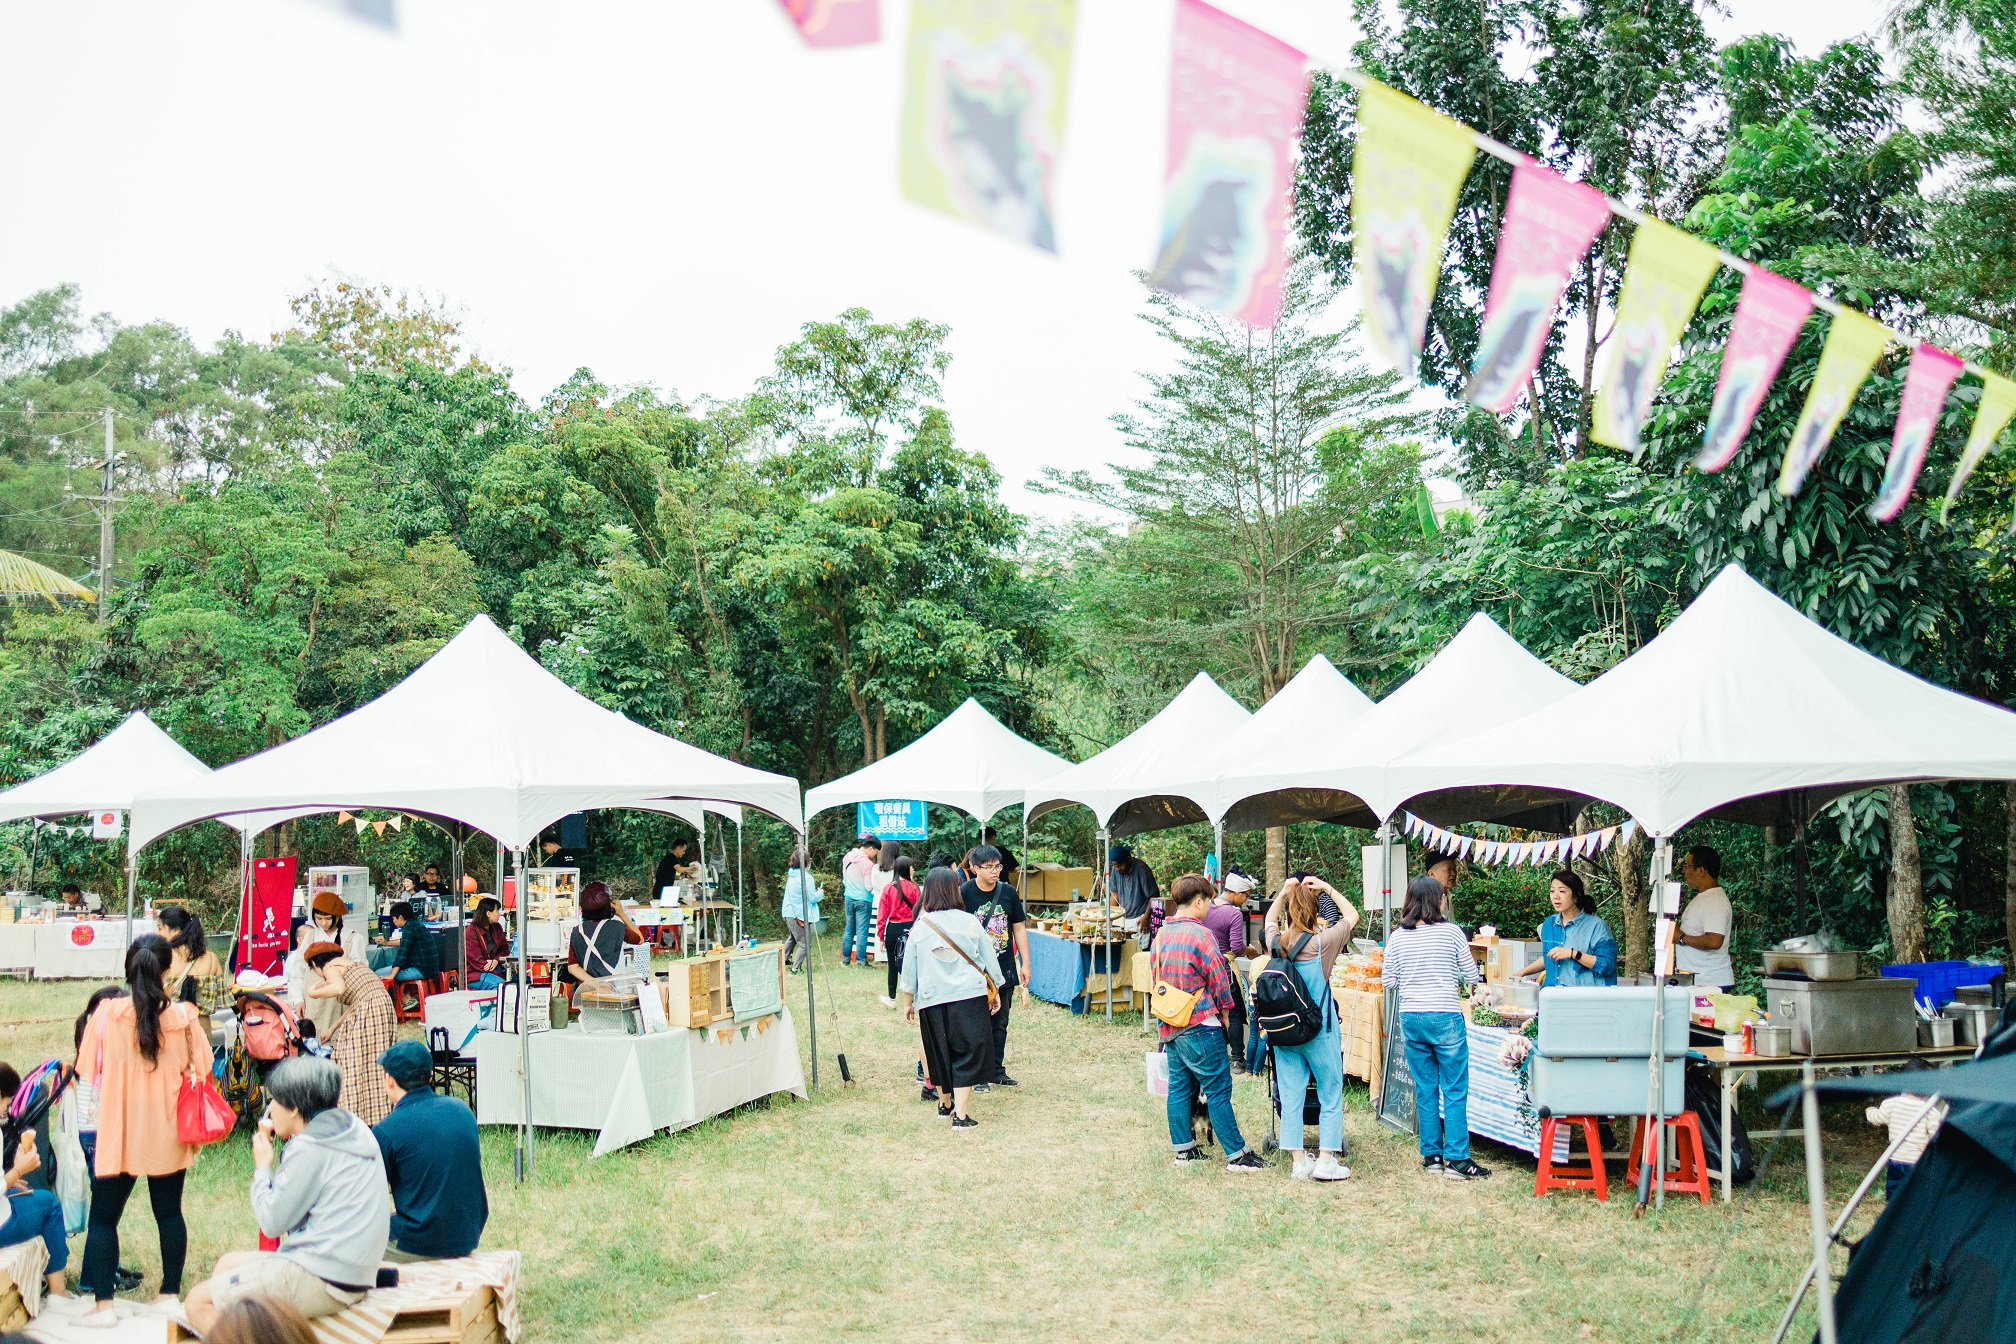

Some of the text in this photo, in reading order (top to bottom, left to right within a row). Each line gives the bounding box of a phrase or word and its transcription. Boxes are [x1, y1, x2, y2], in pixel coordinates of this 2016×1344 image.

[874, 802, 911, 815] 環保餐具
[879, 815, 907, 828] 租借站
[1467, 1166, 1477, 1174] N
